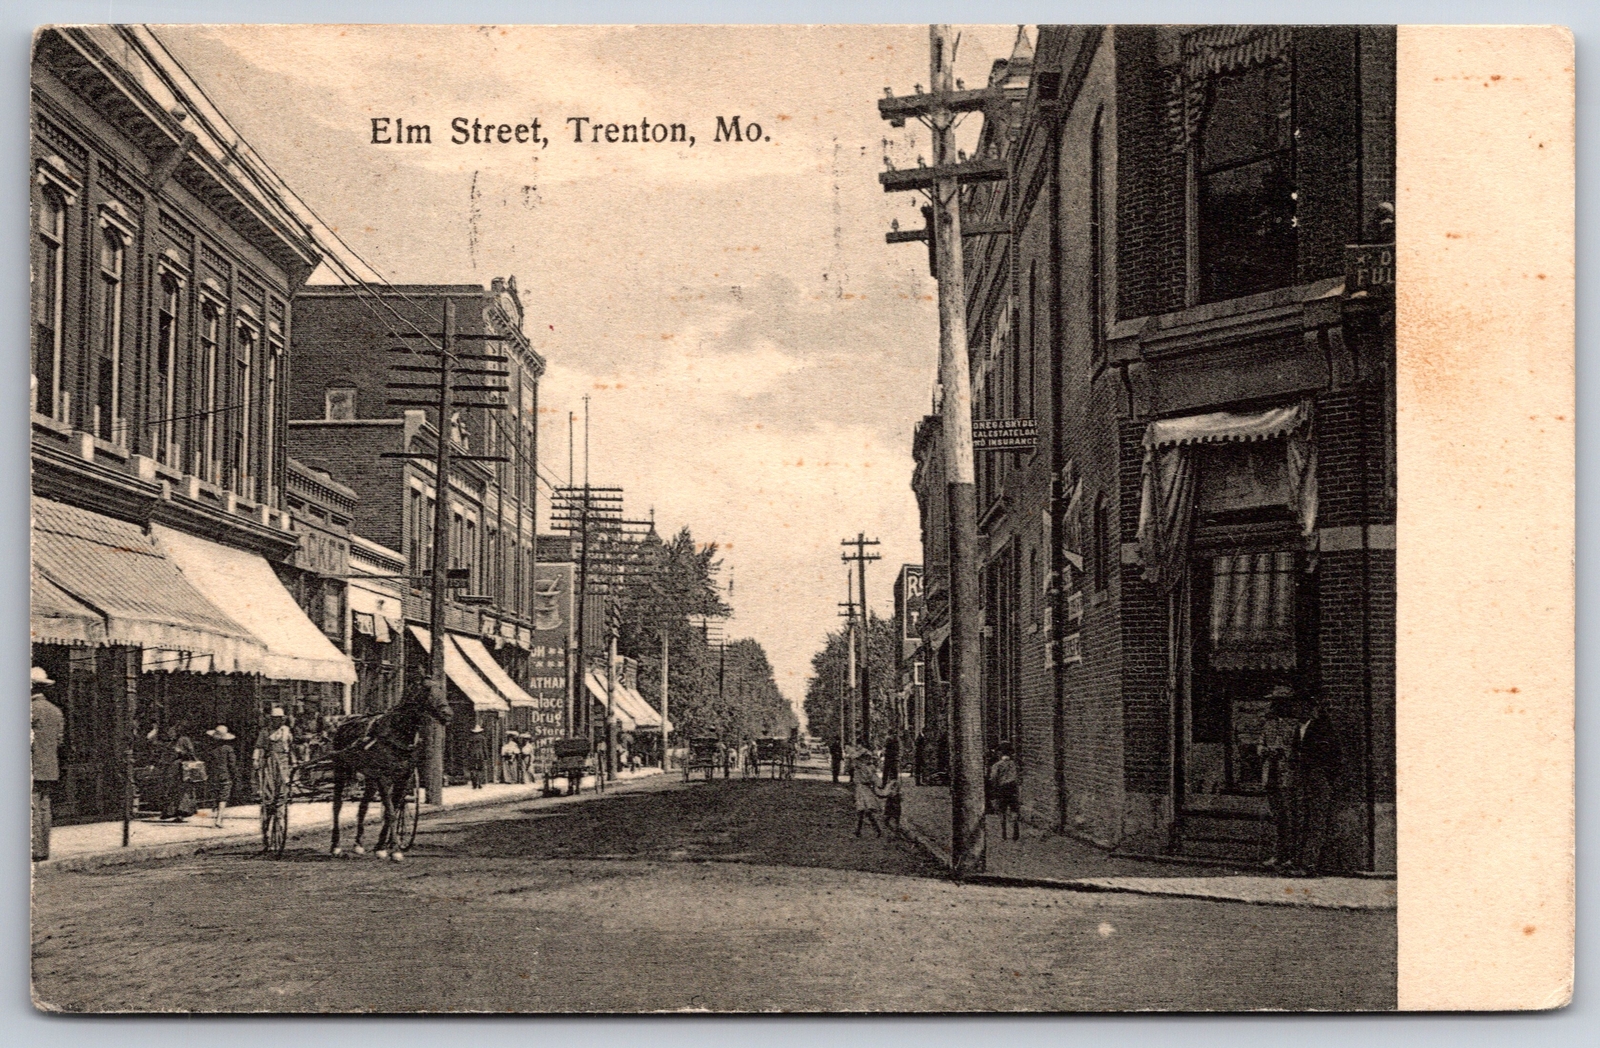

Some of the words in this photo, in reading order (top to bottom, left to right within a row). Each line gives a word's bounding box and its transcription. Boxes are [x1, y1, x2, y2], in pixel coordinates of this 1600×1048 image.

[972, 430, 988, 438] EAL
[988, 437, 1038, 446] INSURANCE
[539, 692, 563, 708] lace
[532, 710, 562, 727] Drug
[535, 725, 565, 736] Store
